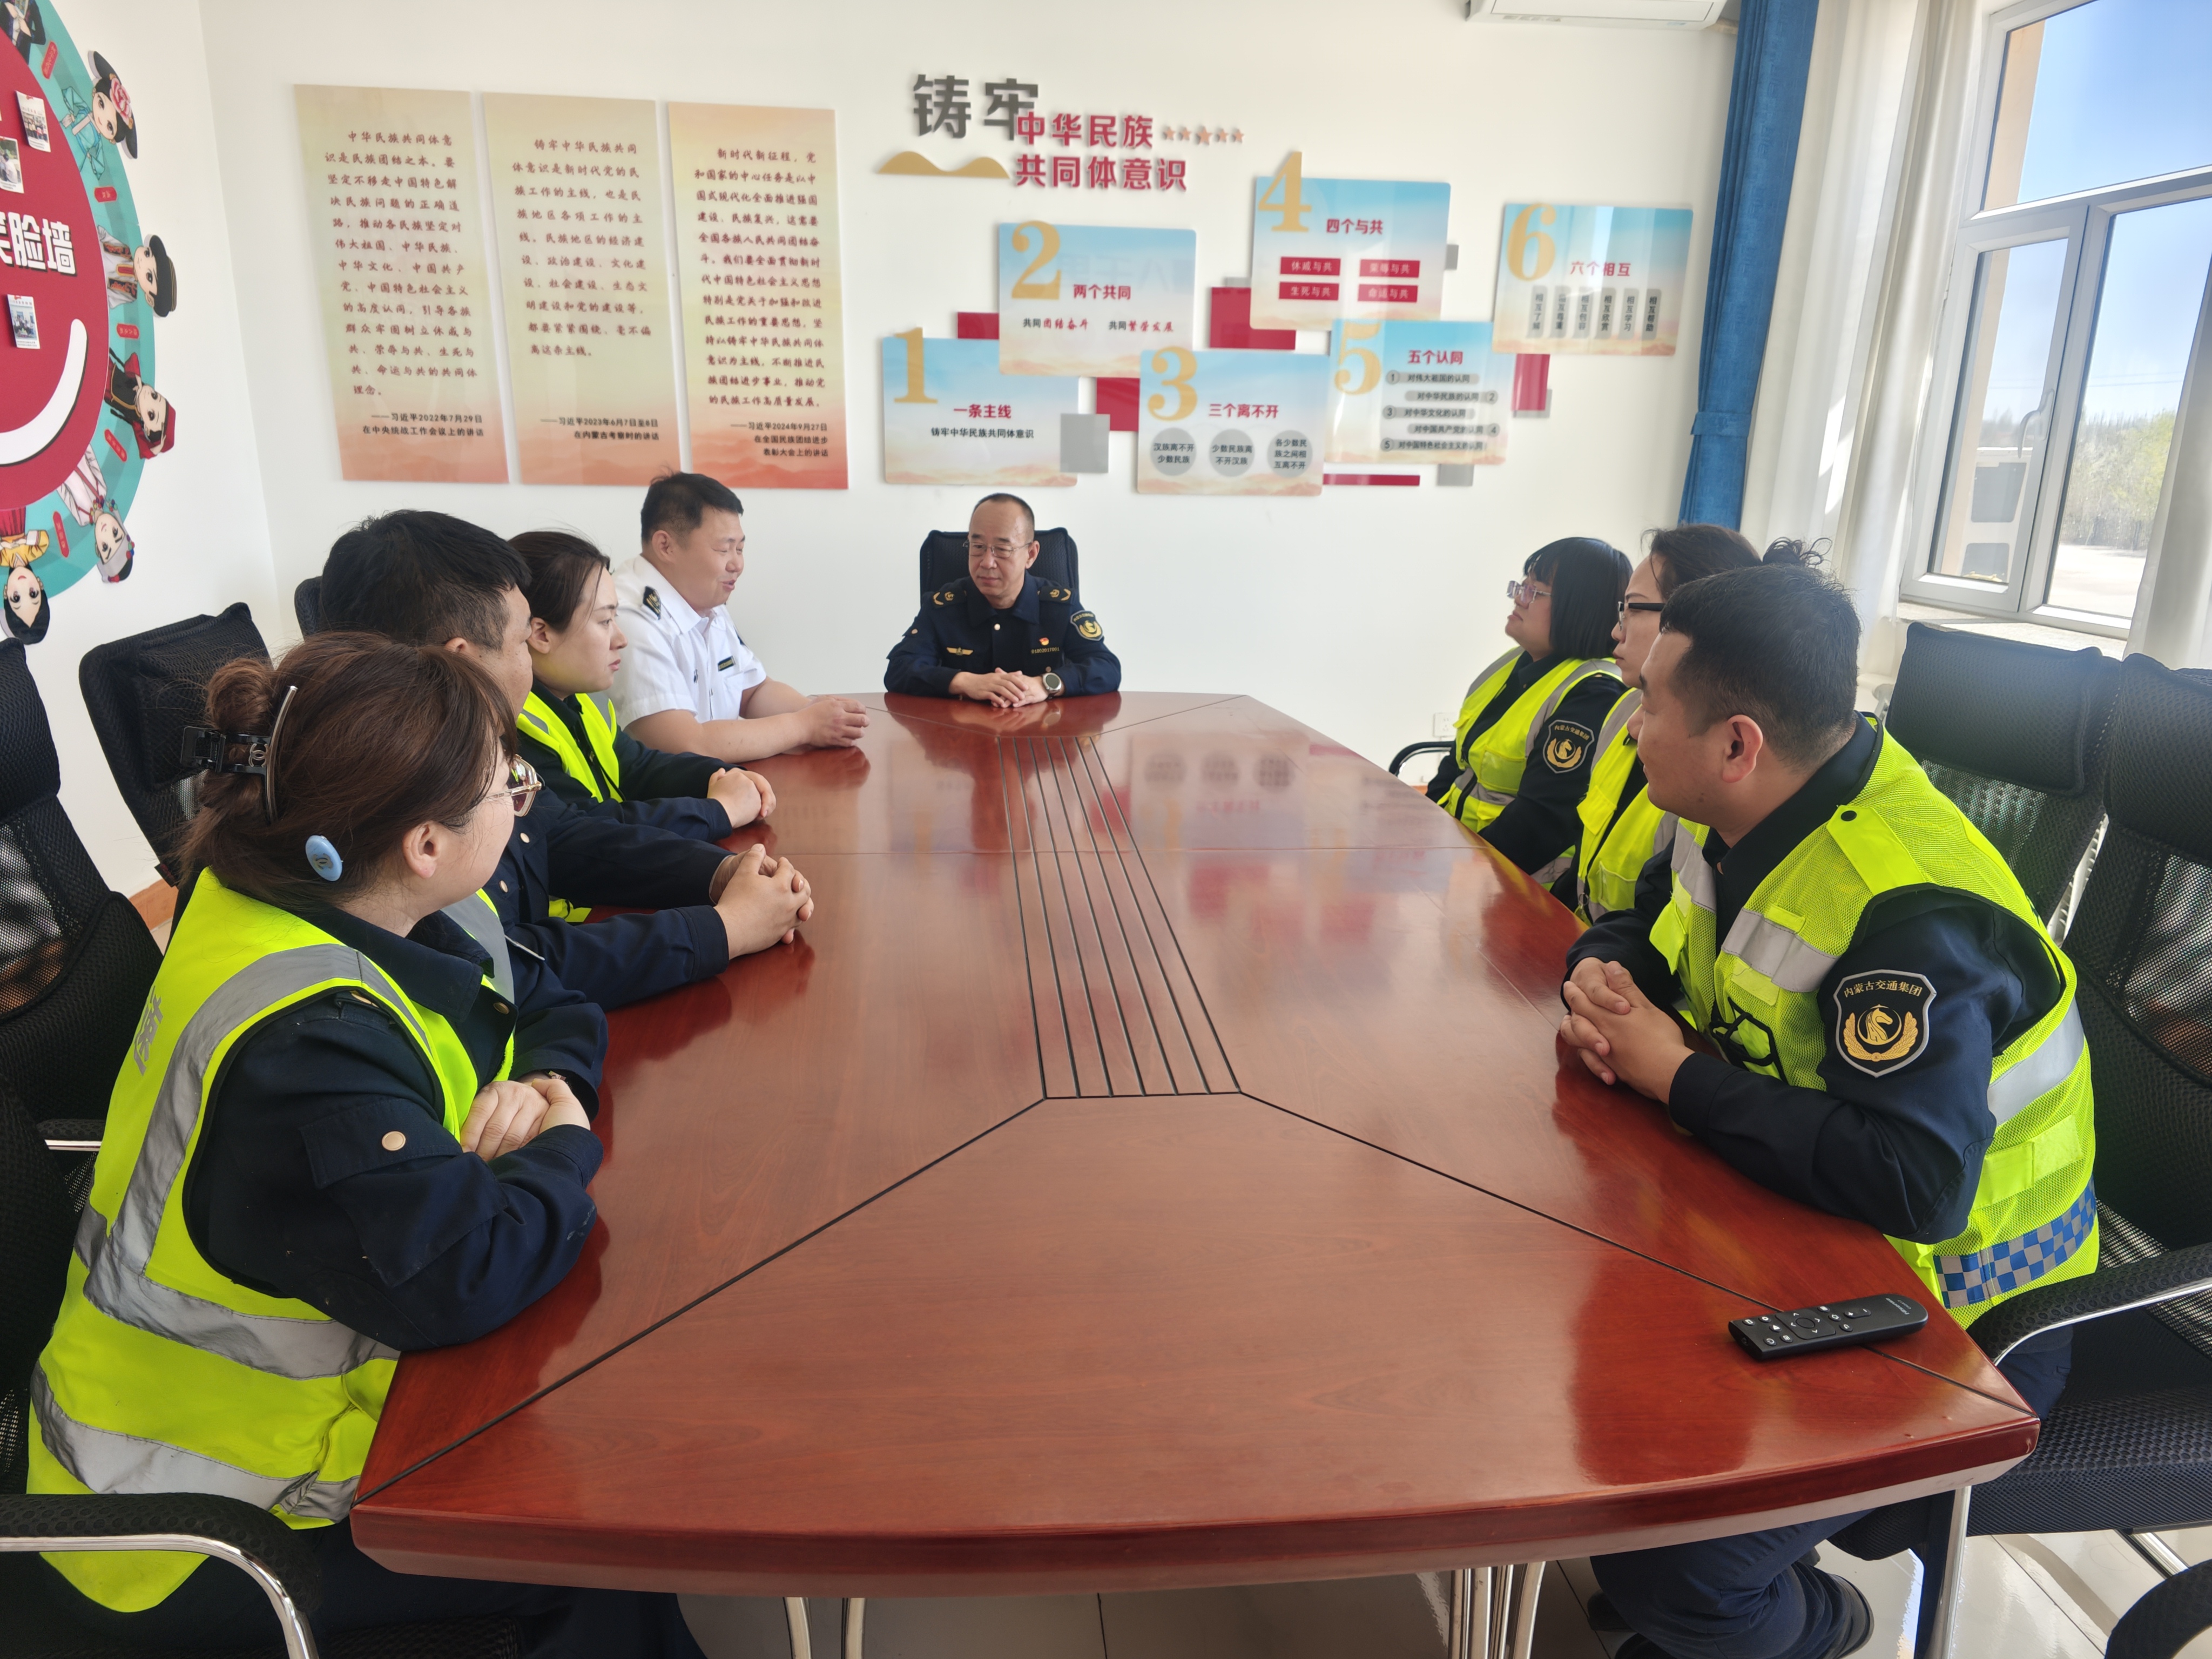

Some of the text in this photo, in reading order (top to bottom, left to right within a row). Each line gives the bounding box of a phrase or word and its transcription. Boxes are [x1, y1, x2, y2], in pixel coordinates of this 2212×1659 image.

[913, 74, 1039, 141] 铸牢
[348, 130, 453, 146] 中华民族共同体意
[1016, 111, 1154, 149] 中华民族
[534, 139, 637, 154] 铸牢中华民族共同
[1015, 153, 1187, 191] 共同体意识
[1258, 151, 1312, 232] 4
[1326, 218, 1384, 235] 四个与共
[1506, 203, 1557, 282] 6
[1011, 220, 1062, 300] 2
[1570, 260, 1631, 277] 六个相互
[1073, 284, 1131, 300] 两个共同
[1290, 285, 1331, 298] 生死与共
[1624, 295, 1635, 332] 相互学习
[894, 326, 938, 404] 1
[1334, 321, 1382, 396] 5
[1407, 349, 1464, 365] 五个认同
[1147, 346, 1198, 421] 3
[1407, 374, 1471, 382] 对伟大祖国的认同
[953, 403, 1011, 419] 一条主线
[1209, 403, 1279, 419] 三个离不开
[930, 427, 1034, 439] 铸牢中华民族共同体意识
[1154, 442, 1195, 451] 汉族离不开
[1212, 444, 1253, 454] 少数民族离
[1275, 439, 1307, 448] 各少数民
[1157, 455, 1190, 464] 少数民族
[1215, 457, 1248, 466] 不开汉族
[1274, 450, 1307, 458] 族之间相
[1274, 461, 1306, 470] 互离不开
[1844, 979, 1923, 998] 内蒙古交通集团
[1885, 1298, 1910, 1315] Hisense
